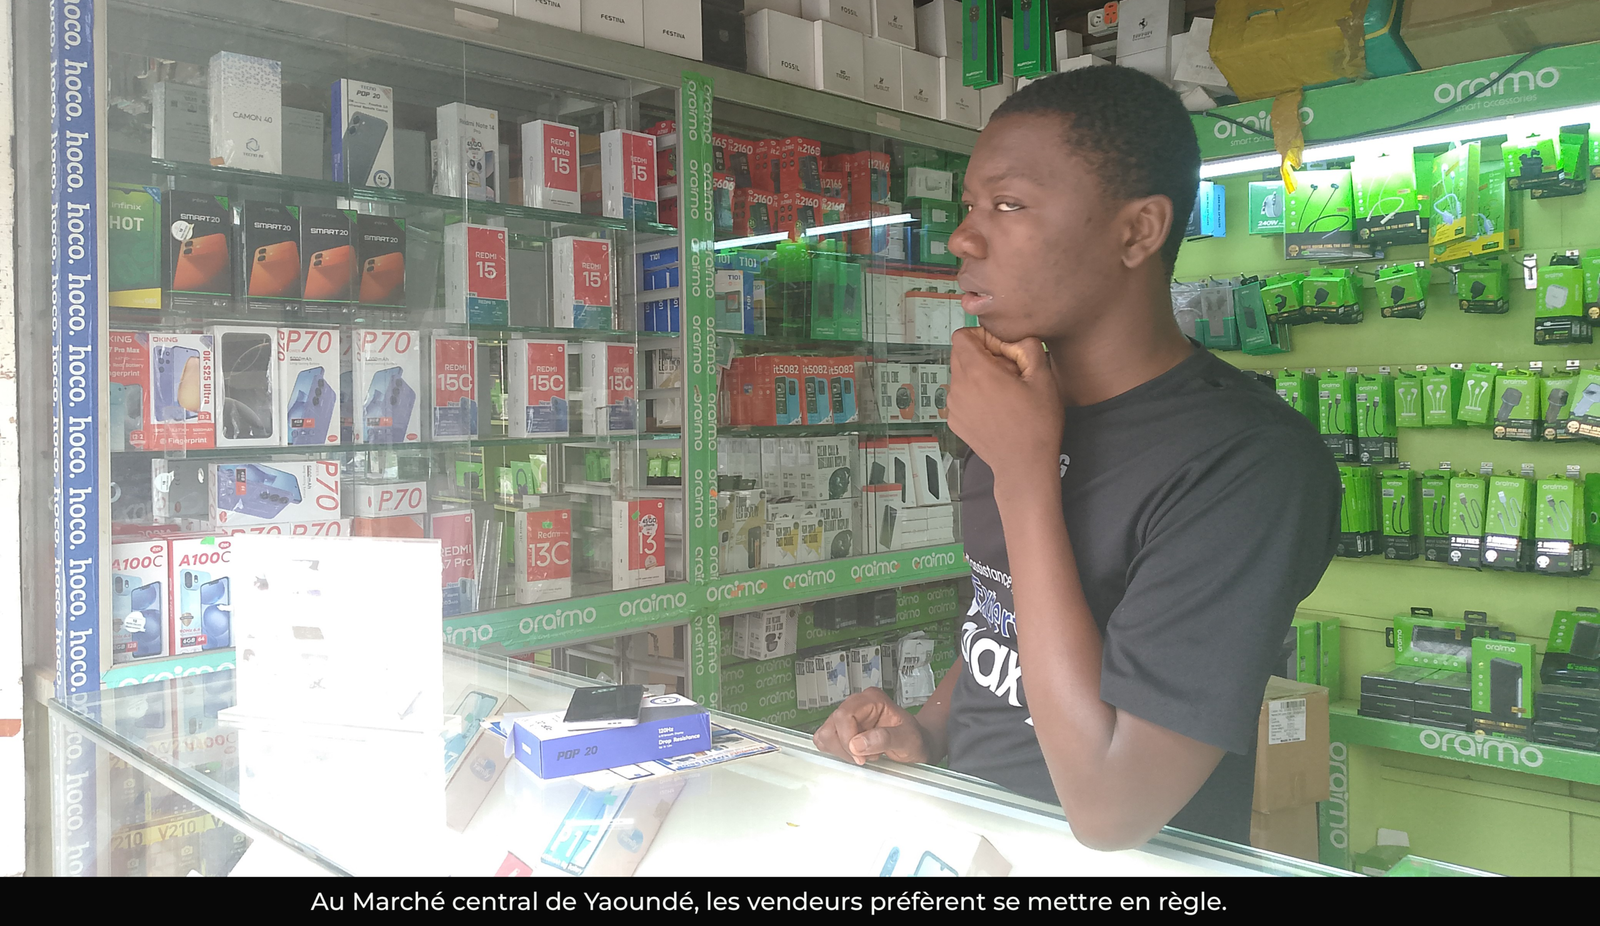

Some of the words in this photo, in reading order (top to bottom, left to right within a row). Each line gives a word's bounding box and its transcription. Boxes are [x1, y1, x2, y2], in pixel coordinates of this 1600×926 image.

[600, 13, 625, 24] FESTINA
[841, 6, 858, 17] FOSSIL
[662, 29, 685, 40] FESTINA
[781, 60, 800, 71] FOSSIL
[836, 72, 850, 81] TISSOT
[1434, 67, 1560, 104] oraimo
[65, 59, 88, 121] hoco.
[689, 80, 698, 142] oraimo
[1454, 102, 1481, 113] smart
[1482, 93, 1538, 109] accessories
[233, 111, 262, 122] CAMON
[263, 115, 273, 124] 40
[703, 84, 712, 144] oraimo
[1213, 106, 1314, 140] oraio
[550, 138, 570, 148] REDMI
[550, 146, 570, 157] Note
[1230, 137, 1252, 147] smart
[66, 130, 89, 193] hoco.
[551, 157, 570, 175] 15
[630, 155, 648, 165] REDMI
[631, 164, 648, 181] 15
[690, 159, 700, 220] oraimo
[704, 162, 713, 222] oraimo
[111, 202, 142, 211] Infinix
[67, 201, 90, 264] hoco.
[109, 215, 145, 232] HOT
[475, 251, 497, 260] REDMI
[739, 256, 757, 268] T101
[476, 261, 497, 279] 15
[582, 262, 601, 270] REDMI
[583, 271, 601, 288] 15
[68, 273, 92, 336] hoco.
[277, 330, 286, 361] P70
[286, 330, 332, 353] P70
[362, 331, 411, 353] P70
[692, 315, 702, 374] oraimo
[707, 317, 716, 375] oraimo
[68, 345, 92, 407] hoco.
[203, 351, 212, 381] OK-S25
[445, 363, 467, 371] REDMI
[773, 364, 799, 374] it5082
[802, 364, 828, 374] it5082
[828, 364, 854, 375] it5082
[438, 373, 473, 391] 15C
[529, 375, 564, 392] 15C
[608, 376, 633, 392] 15C
[203, 384, 212, 405] Ultra
[694, 392, 703, 451] oraimo
[708, 393, 717, 451] oraimo
[69, 416, 92, 478] hoco.
[316, 461, 339, 511] P70
[378, 488, 423, 512] P70
[695, 469, 704, 528] oraimo
[69, 487, 92, 550] hoco.
[537, 530, 560, 539] Redmi
[638, 532, 657, 554] 13
[112, 555, 164, 571] A100C
[178, 551, 231, 567] A100C
[454, 558, 472, 568] Pro
[529, 541, 570, 567] 13C
[912, 552, 955, 570] oraimo
[783, 569, 836, 590] oraimo
[851, 560, 899, 580] oraimo
[69, 558, 93, 622] hoco.
[707, 579, 766, 602] oraimo
[619, 592, 687, 618] oraimo
[519, 606, 597, 634] oraimo
[695, 615, 704, 676] oraimo
[707, 614, 717, 674] oraimo
[1485, 644, 1516, 653] oraimo
[70, 628, 93, 692] hoco.
[755, 658, 792, 675] oraimo
[756, 672, 792, 689] oraimo
[759, 689, 796, 707] oraimo
[658, 727, 674, 735] 120Hz
[658, 737, 672, 746] Drop
[673, 733, 700, 744] Resistance
[556, 748, 580, 762] POP
[584, 745, 598, 757] 20
[1419, 729, 1544, 768] oraimo
[67, 771, 89, 836] hoco.
[1329, 742, 1348, 849] oraimo
[158, 820, 197, 842] V210
